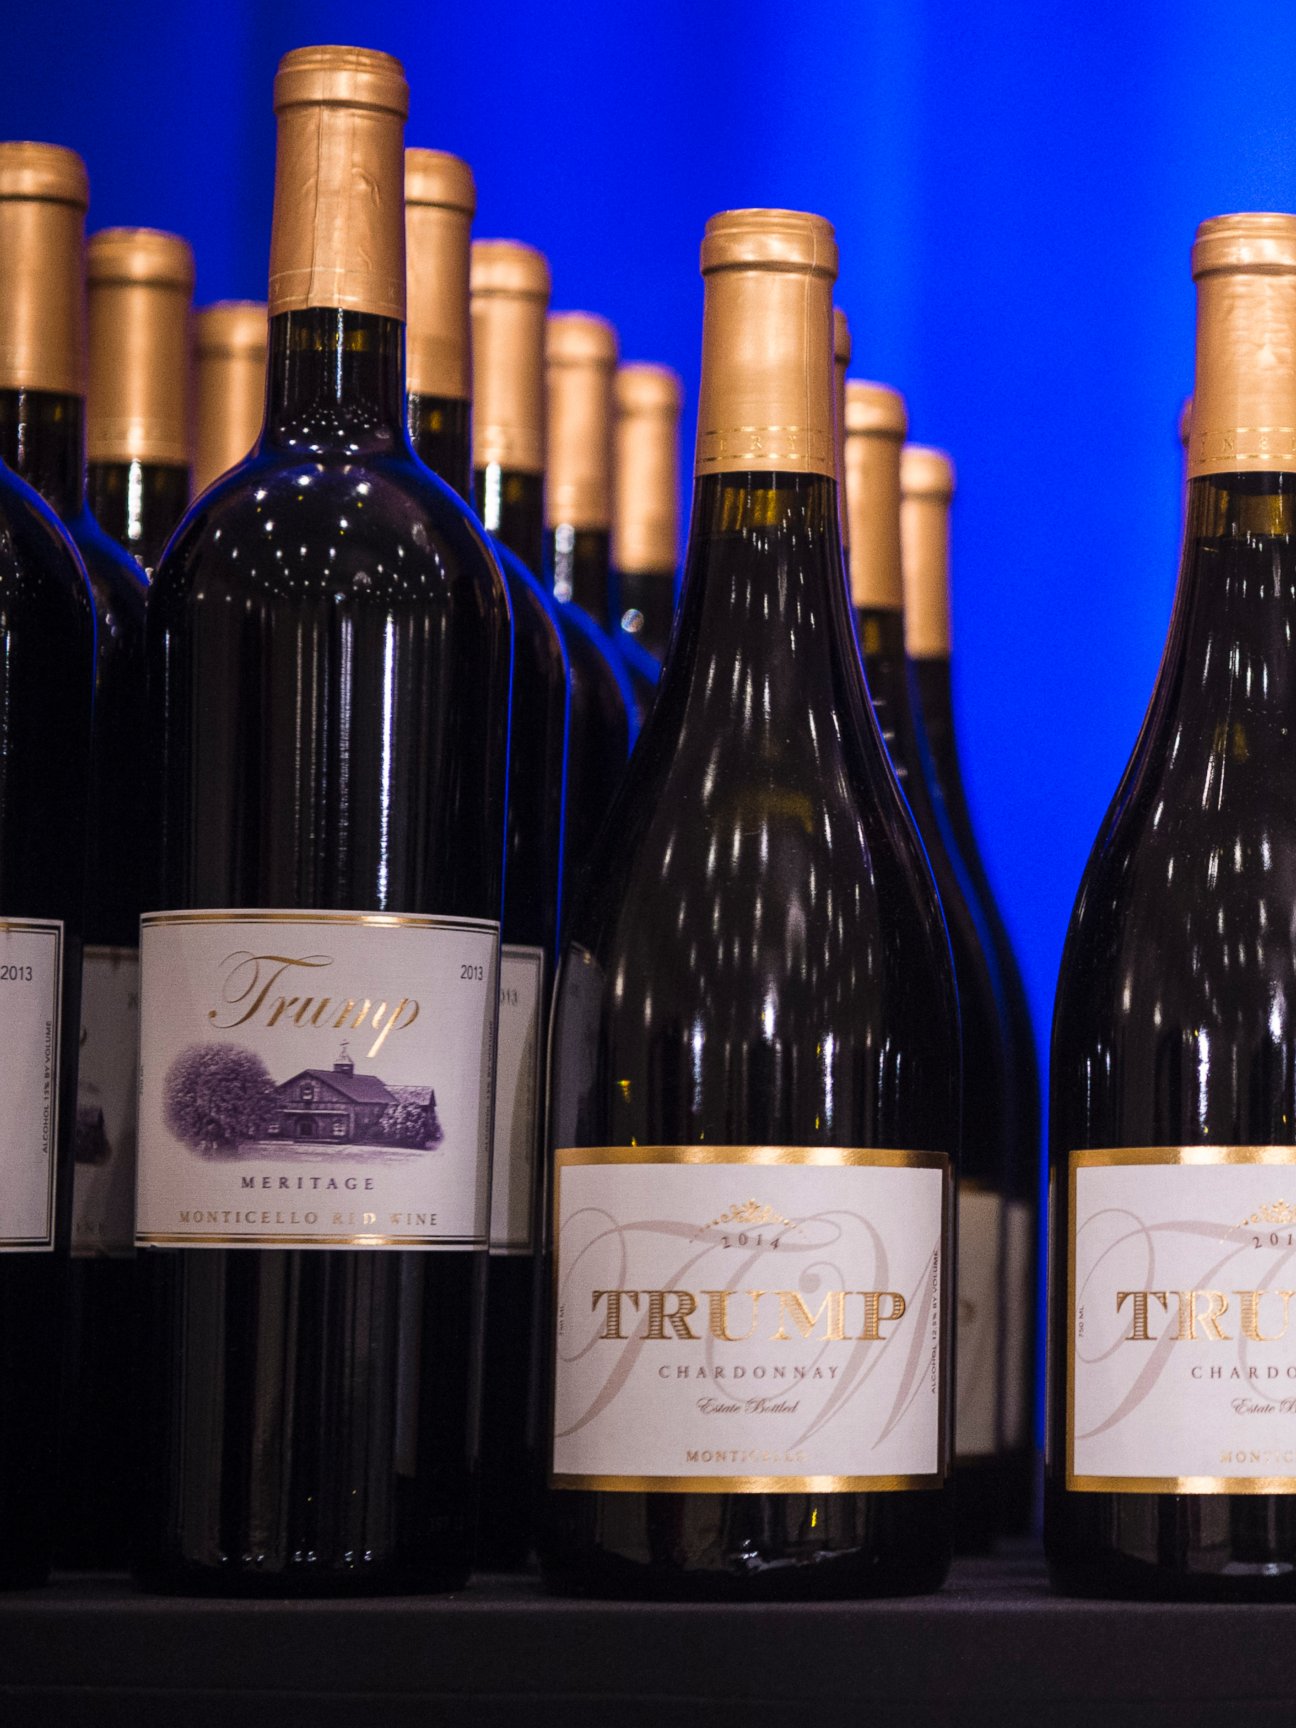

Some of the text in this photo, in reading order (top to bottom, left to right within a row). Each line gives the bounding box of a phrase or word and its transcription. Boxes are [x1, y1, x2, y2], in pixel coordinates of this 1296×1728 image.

[0, 965, 34, 983] 2013
[460, 964, 485, 982] 2013
[208, 950, 420, 1058] Trump
[42, 1105, 50, 1154] ALCOHOL
[240, 1175, 375, 1191] MERITAGE
[178, 1210, 318, 1225] MONTICELLO
[721, 1231, 782, 1251] 2014
[591, 1289, 907, 1342] TRUMP
[658, 1365, 840, 1380] CHARDONNAY
[695, 1397, 801, 1415] Estate Bottled
[1231, 1398, 1276, 1415] Estate
